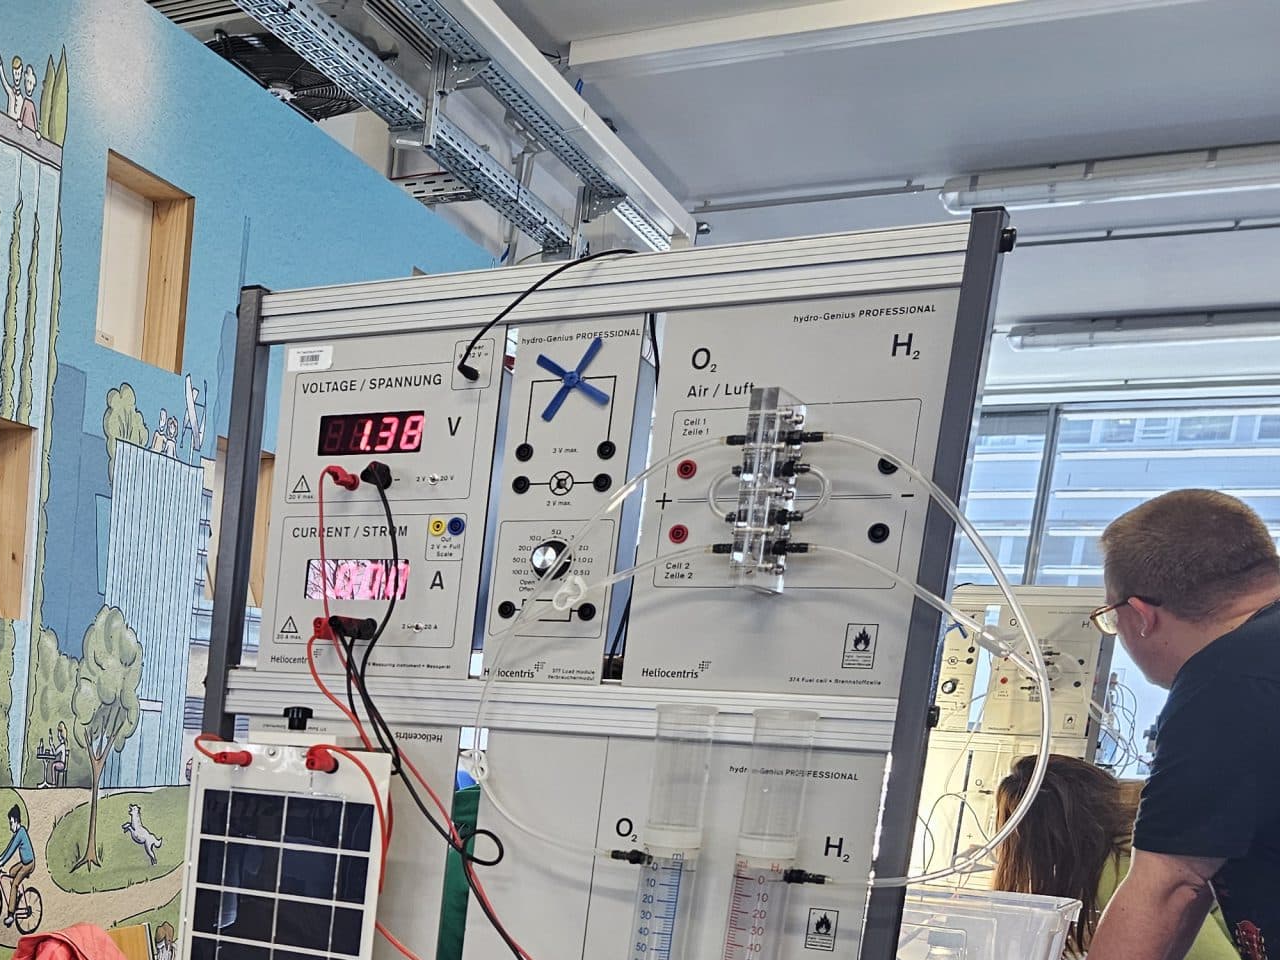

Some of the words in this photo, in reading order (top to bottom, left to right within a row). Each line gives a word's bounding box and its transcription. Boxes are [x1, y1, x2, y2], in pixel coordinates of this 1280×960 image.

[793, 310, 856, 323] hydro-Genius
[858, 304, 937, 318] PROFESSIONAL
[521, 334, 574, 346] hydro-Genius
[576, 327, 641, 341] PROFESSIONAL
[302, 379, 358, 395] VOLTAGE
[369, 373, 443, 390] SPANNUNG
[686, 385, 709, 398] Air
[724, 381, 756, 396] Luft
[447, 416, 462, 437] V
[683, 418, 700, 427] Cell
[359, 415, 425, 452] 1.38
[682, 427, 702, 436] Zelle
[665, 562, 683, 570] Cell
[684, 562, 690, 570] 2
[429, 569, 445, 591] A
[664, 571, 686, 580] Zelle
[686, 572, 693, 580] 2
[270, 655, 308, 664] Heliocentr
[641, 667, 699, 679] Heliocentris
[395, 731, 444, 743] Heliocentris
[646, 878, 656, 888] 10
[642, 894, 654, 904] 20
[640, 910, 652, 920] 30
[752, 909, 767, 919] 20
[637, 927, 649, 936] 40
[750, 926, 764, 936] 30
[635, 942, 647, 952] 50
